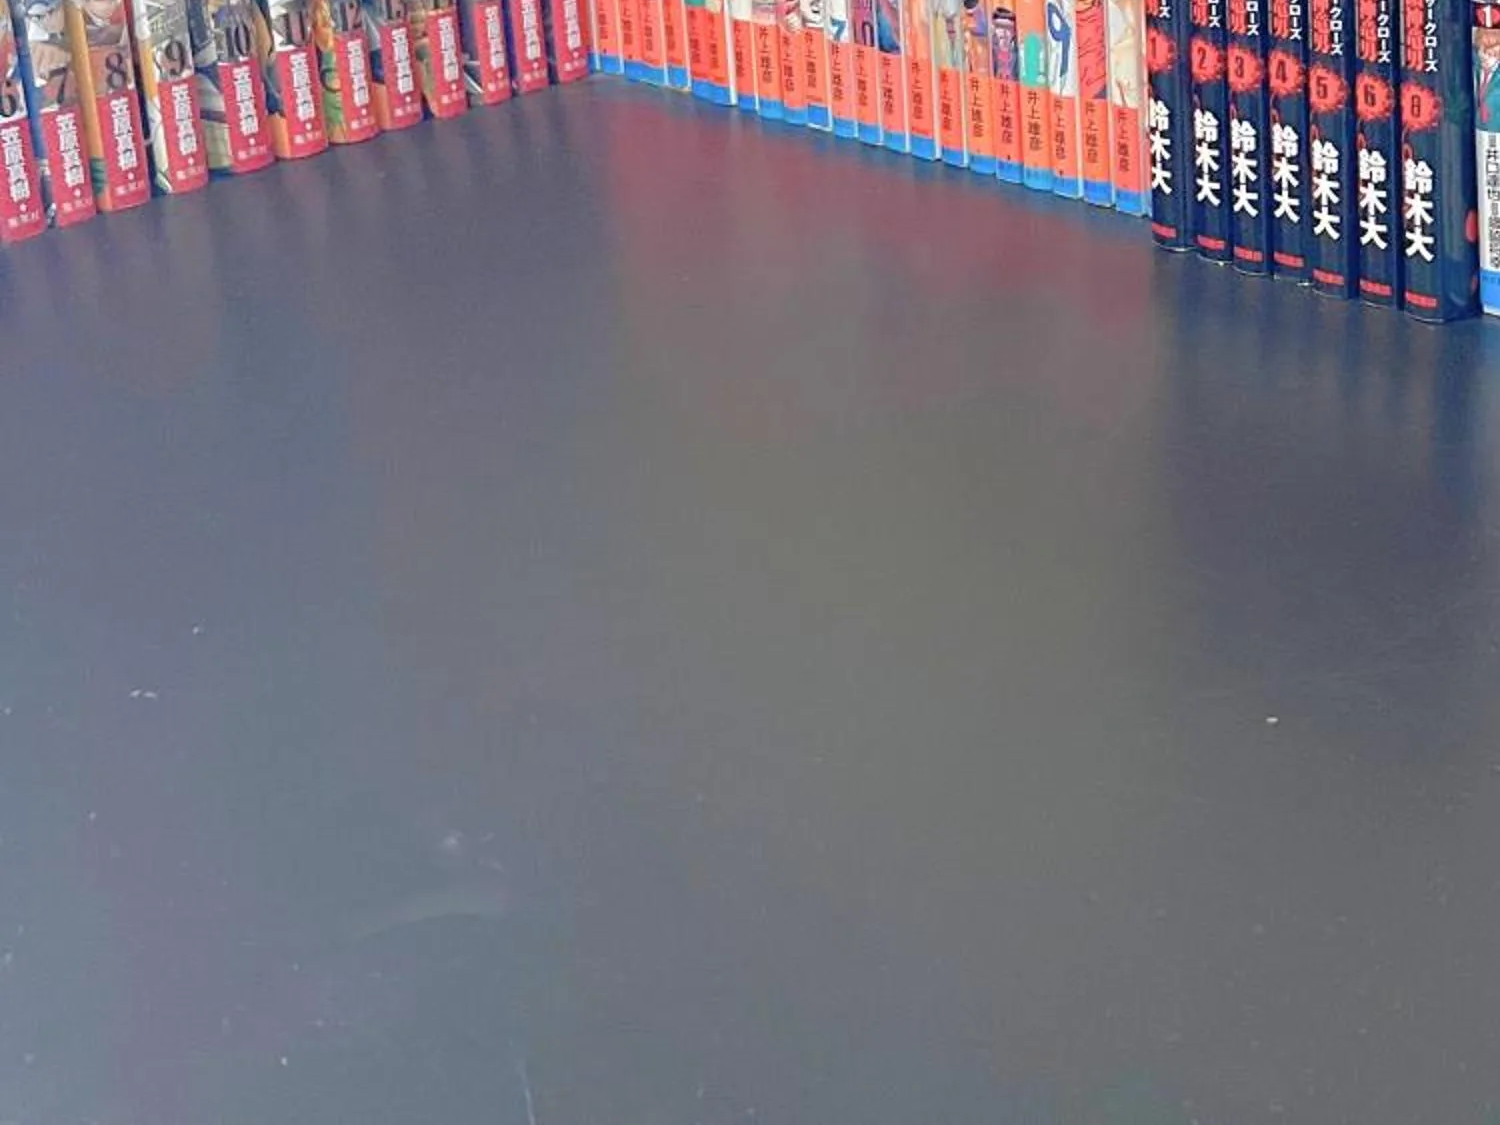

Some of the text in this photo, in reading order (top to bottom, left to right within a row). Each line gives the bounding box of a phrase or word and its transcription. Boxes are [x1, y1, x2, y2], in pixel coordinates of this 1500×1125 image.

[164, 39, 185, 76] 9
[1483, 7, 1493, 27] 1
[105, 52, 125, 88] 8
[1149, 100, 1172, 195] 鈴木大
[1193, 108, 1221, 207] 鈴木大
[1230, 118, 1258, 218] 鈴木大
[1271, 122, 1300, 223] 鈴木大
[1311, 139, 1340, 241] 鈴木大
[1358, 147, 1387, 250] 鈴木大
[1404, 158, 1435, 262] 鈴木大
